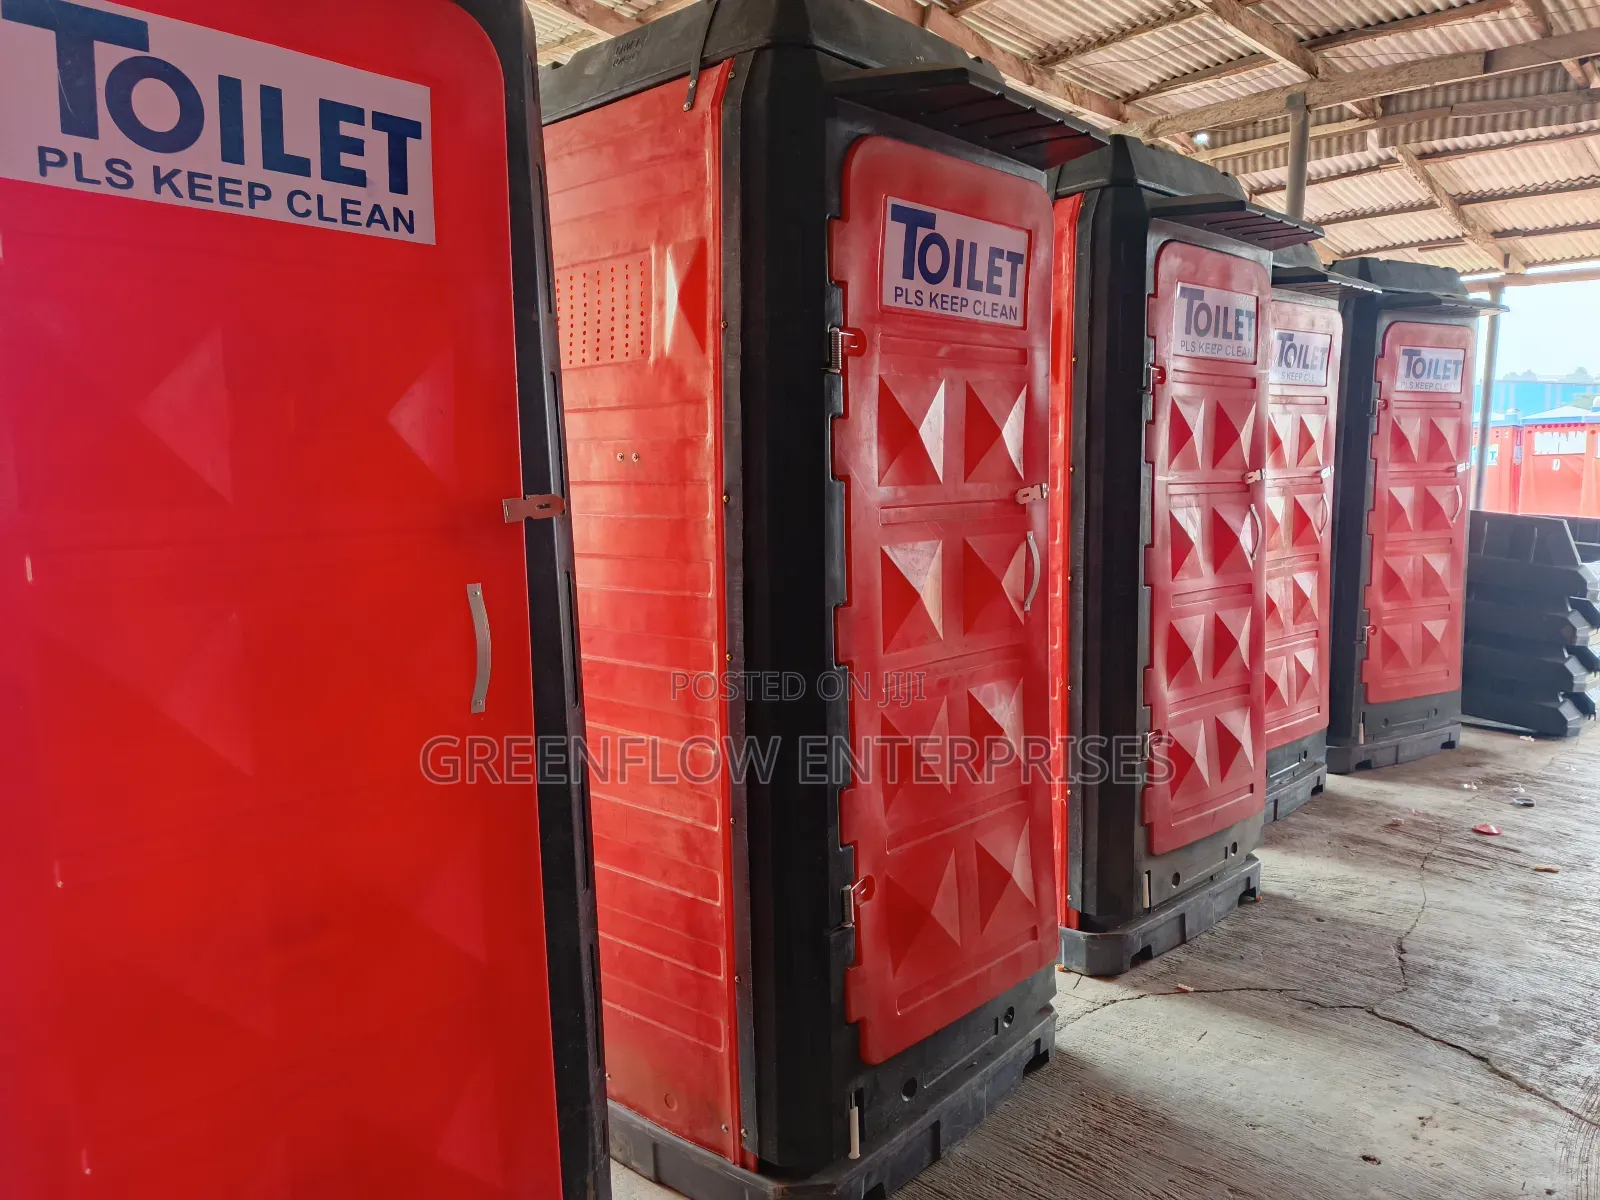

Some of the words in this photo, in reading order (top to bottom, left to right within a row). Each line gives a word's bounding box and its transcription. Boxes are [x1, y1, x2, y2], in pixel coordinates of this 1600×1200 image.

[1, 0, 422, 195] TOILET
[38, 145, 134, 190] PLS
[153, 165, 272, 210] KEEP
[286, 189, 415, 235] CLEAN
[891, 204, 1024, 298] TOILET
[894, 286, 924, 307] PLS
[929, 292, 969, 312] KEEP
[972, 300, 1018, 321] CLEAN
[1180, 286, 1255, 342] TOILET
[1180, 340, 1196, 353] PLS
[1199, 342, 1223, 355] KEEP
[1277, 332, 1328, 370] TOILET
[1402, 349, 1462, 380] TOILET
[1286, 371, 1303, 381] KEEP
[1415, 381, 1434, 390] KEEP
